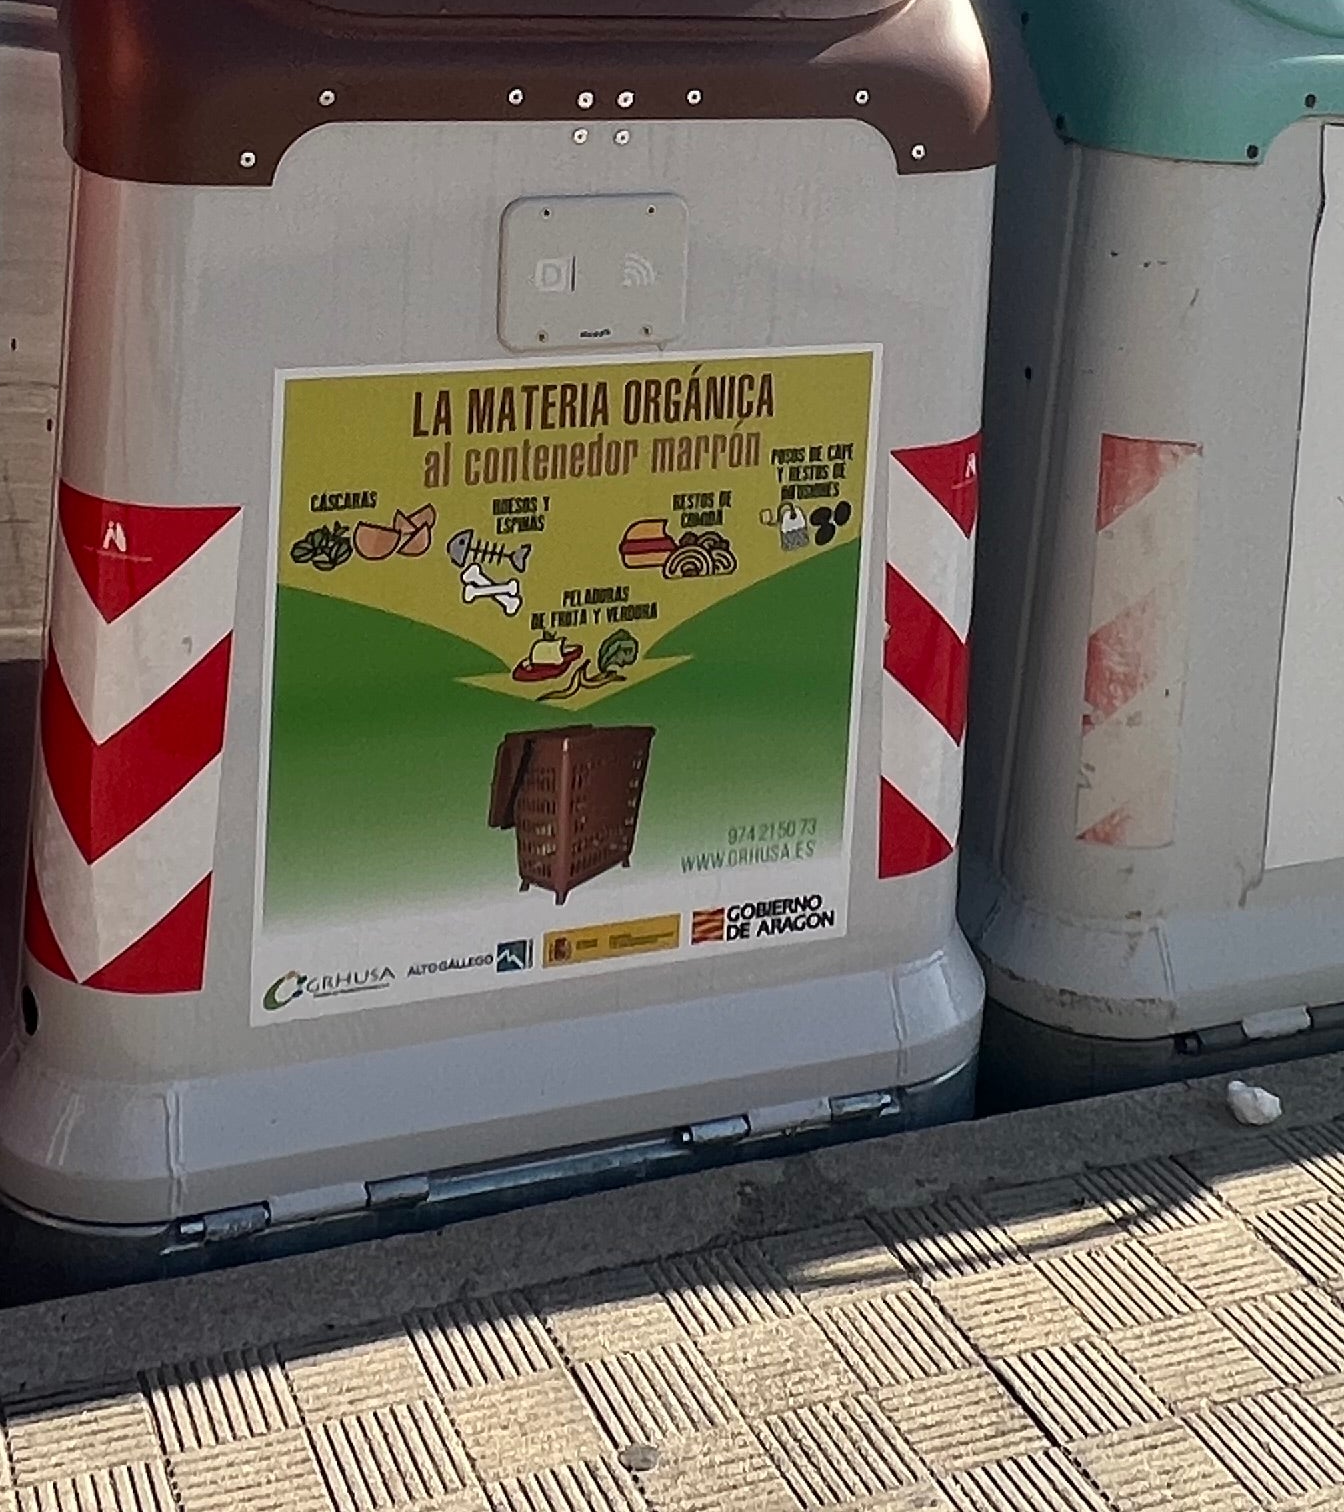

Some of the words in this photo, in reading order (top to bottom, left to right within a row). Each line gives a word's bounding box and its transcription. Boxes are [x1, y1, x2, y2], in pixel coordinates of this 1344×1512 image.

[412, 390, 453, 439] LA
[466, 381, 610, 435] MATERIA
[623, 364, 775, 425] ORGÁNICA
[423, 441, 453, 490] al
[464, 432, 640, 487] contenedor
[650, 419, 762, 474] marrón
[492, 498, 538, 515] HUESOS
[542, 496, 551, 511] Y
[672, 493, 716, 511] RESTOS
[496, 515, 545, 534] ESPINAS
[550, 608, 588, 628] FRUTA
[593, 608, 601, 624] Y
[606, 602, 658, 624] VERDURA
[727, 825, 756, 846] 974
[800, 817, 818, 836] 73
[726, 894, 823, 923] GOBIERNO
[726, 922, 751, 942] DE
